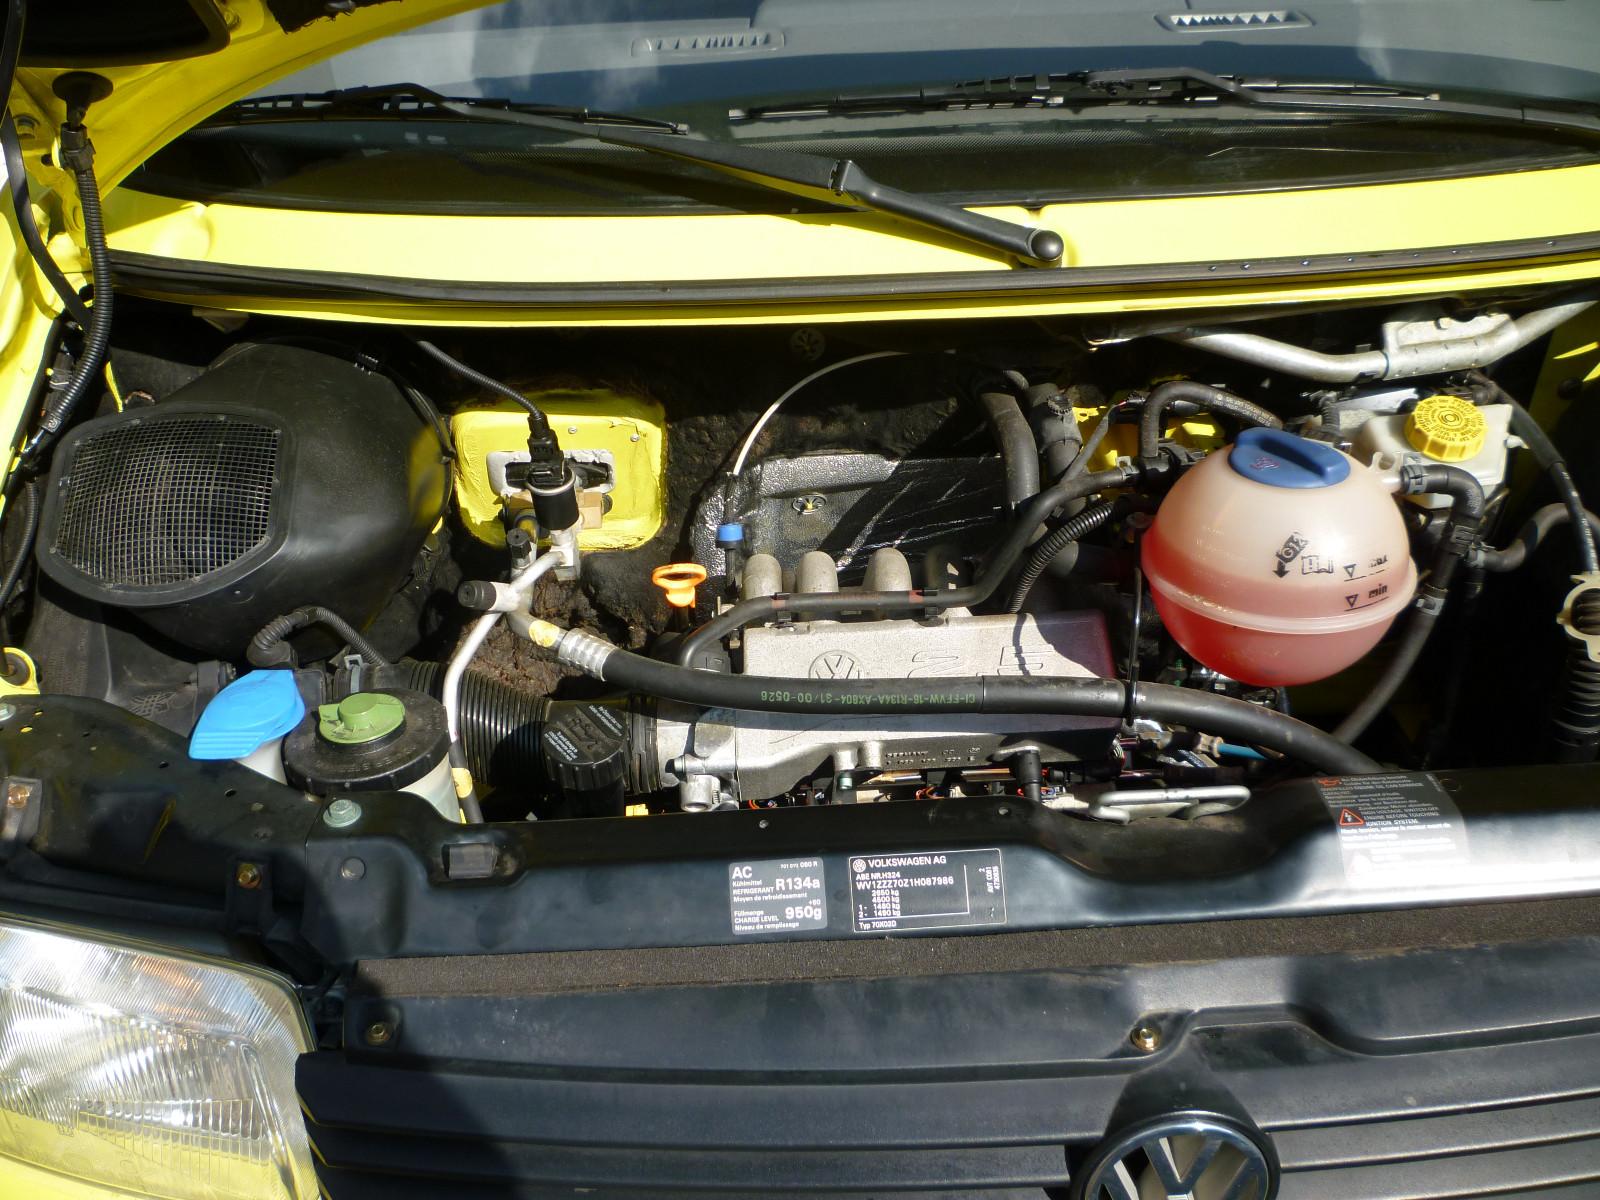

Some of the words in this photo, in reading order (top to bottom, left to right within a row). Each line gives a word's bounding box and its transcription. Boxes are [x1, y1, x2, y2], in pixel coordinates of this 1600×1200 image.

[1368, 584, 1388, 598] min
[868, 857, 931, 868] VOLKSWAGEN
[933, 856, 946, 864] AG
[732, 866, 752, 879] AC
[733, 887, 775, 895] REFRIGERANT
[775, 877, 820, 891] R134a
[890, 889, 899, 897] kg
[891, 896, 900, 904] kg
[892, 903, 900, 911] kg
[785, 905, 822, 920] 950g
[892, 909, 900, 917] kg
[859, 922, 870, 930] Typ
